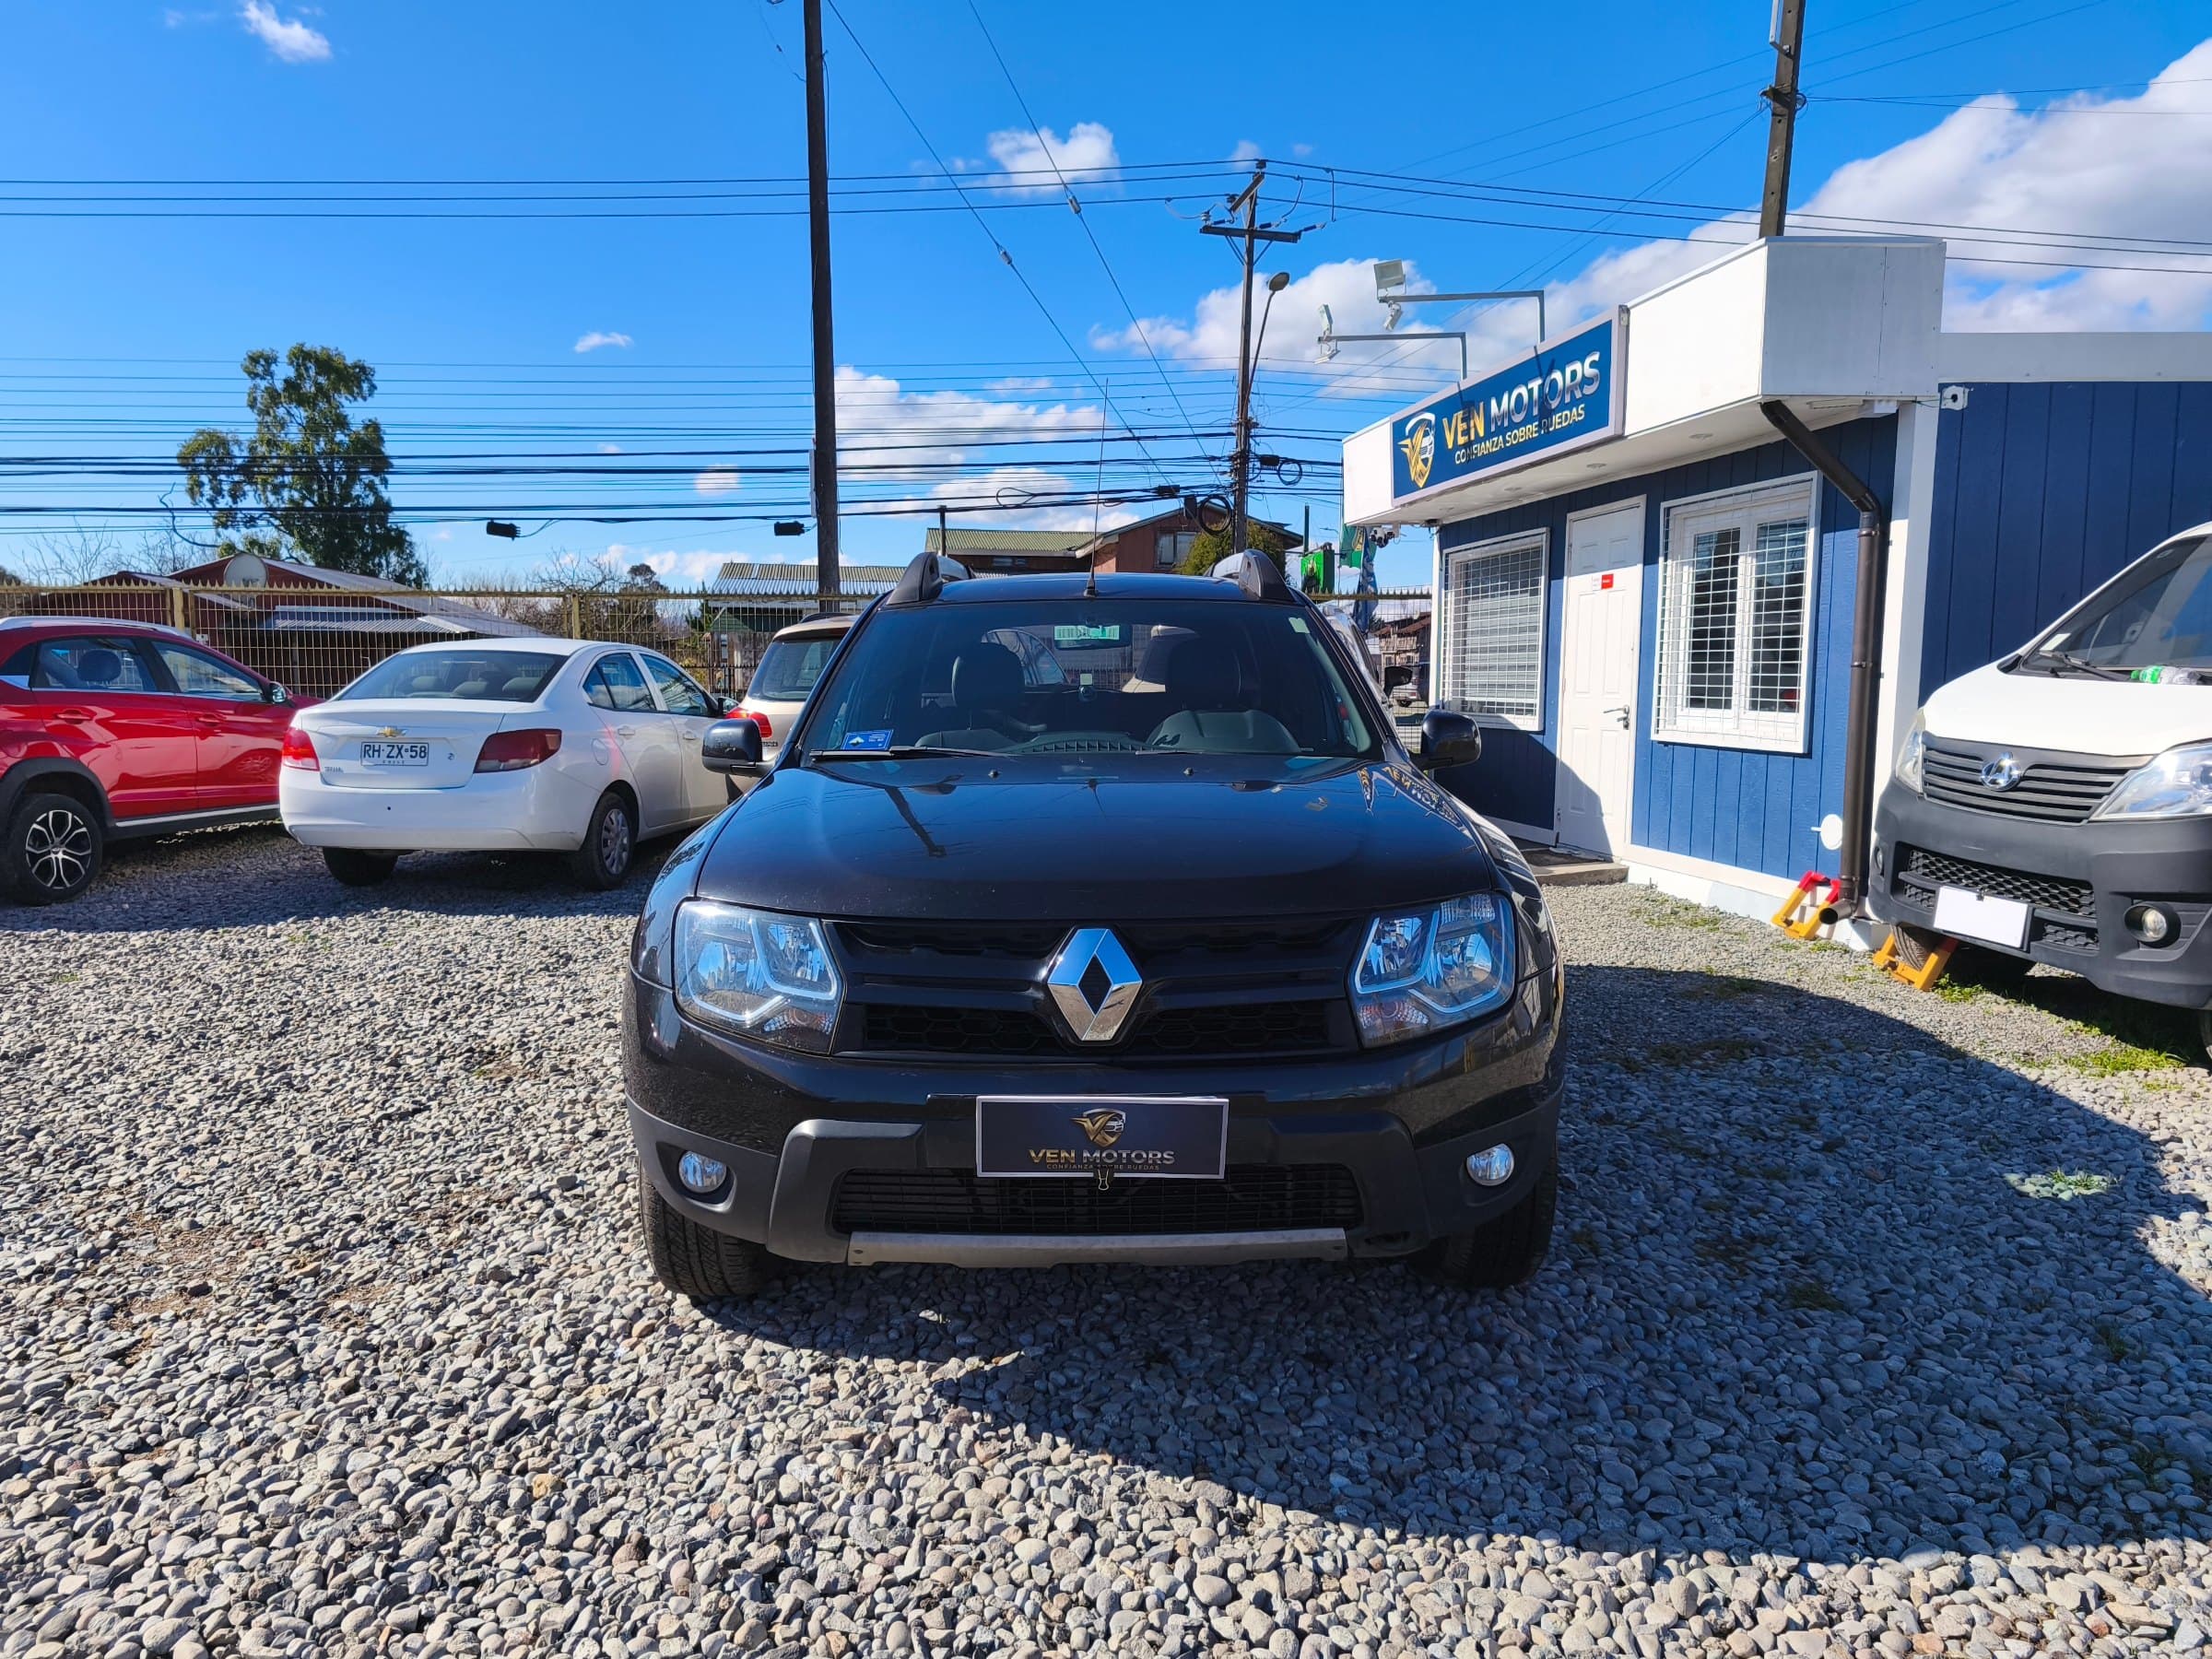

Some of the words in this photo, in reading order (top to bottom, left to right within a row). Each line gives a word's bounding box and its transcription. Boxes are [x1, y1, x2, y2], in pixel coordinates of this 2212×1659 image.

[1442, 401, 1485, 449] VEN
[1490, 351, 1600, 432] MOTORS
[1454, 435, 1504, 464] CONFIANZA
[1505, 422, 1539, 446] SOBRE
[1541, 404, 1585, 434] RUEDAS
[1029, 1148, 1076, 1163] VEN
[1082, 1149, 1175, 1164] MOTORS
